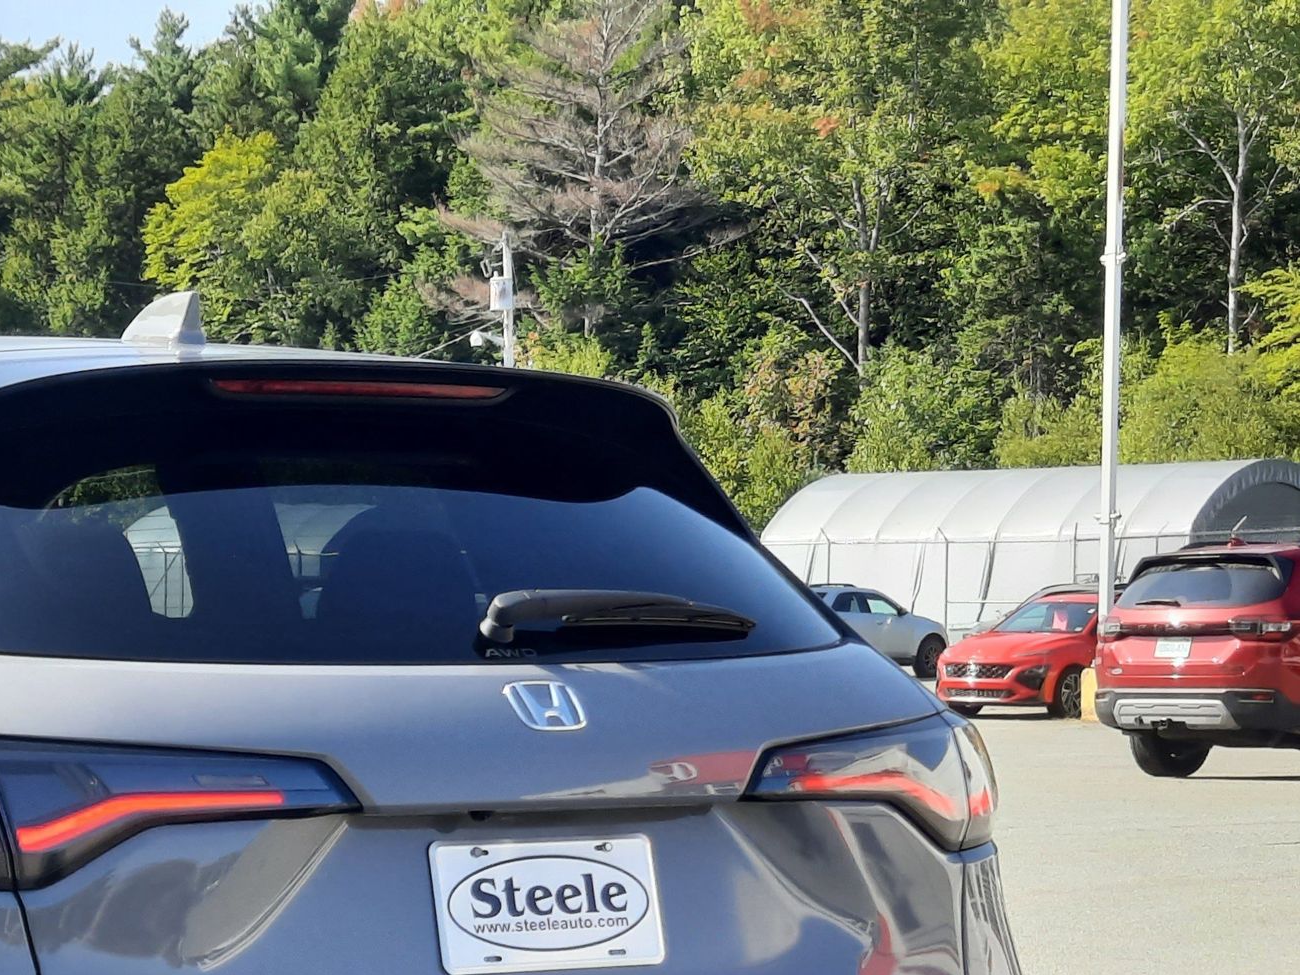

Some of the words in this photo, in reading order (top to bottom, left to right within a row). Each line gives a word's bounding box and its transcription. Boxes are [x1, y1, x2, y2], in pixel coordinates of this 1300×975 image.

[485, 648, 537, 657] AWD
[470, 873, 628, 919] Steele
[473, 916, 629, 935] www.steeleauto.com
